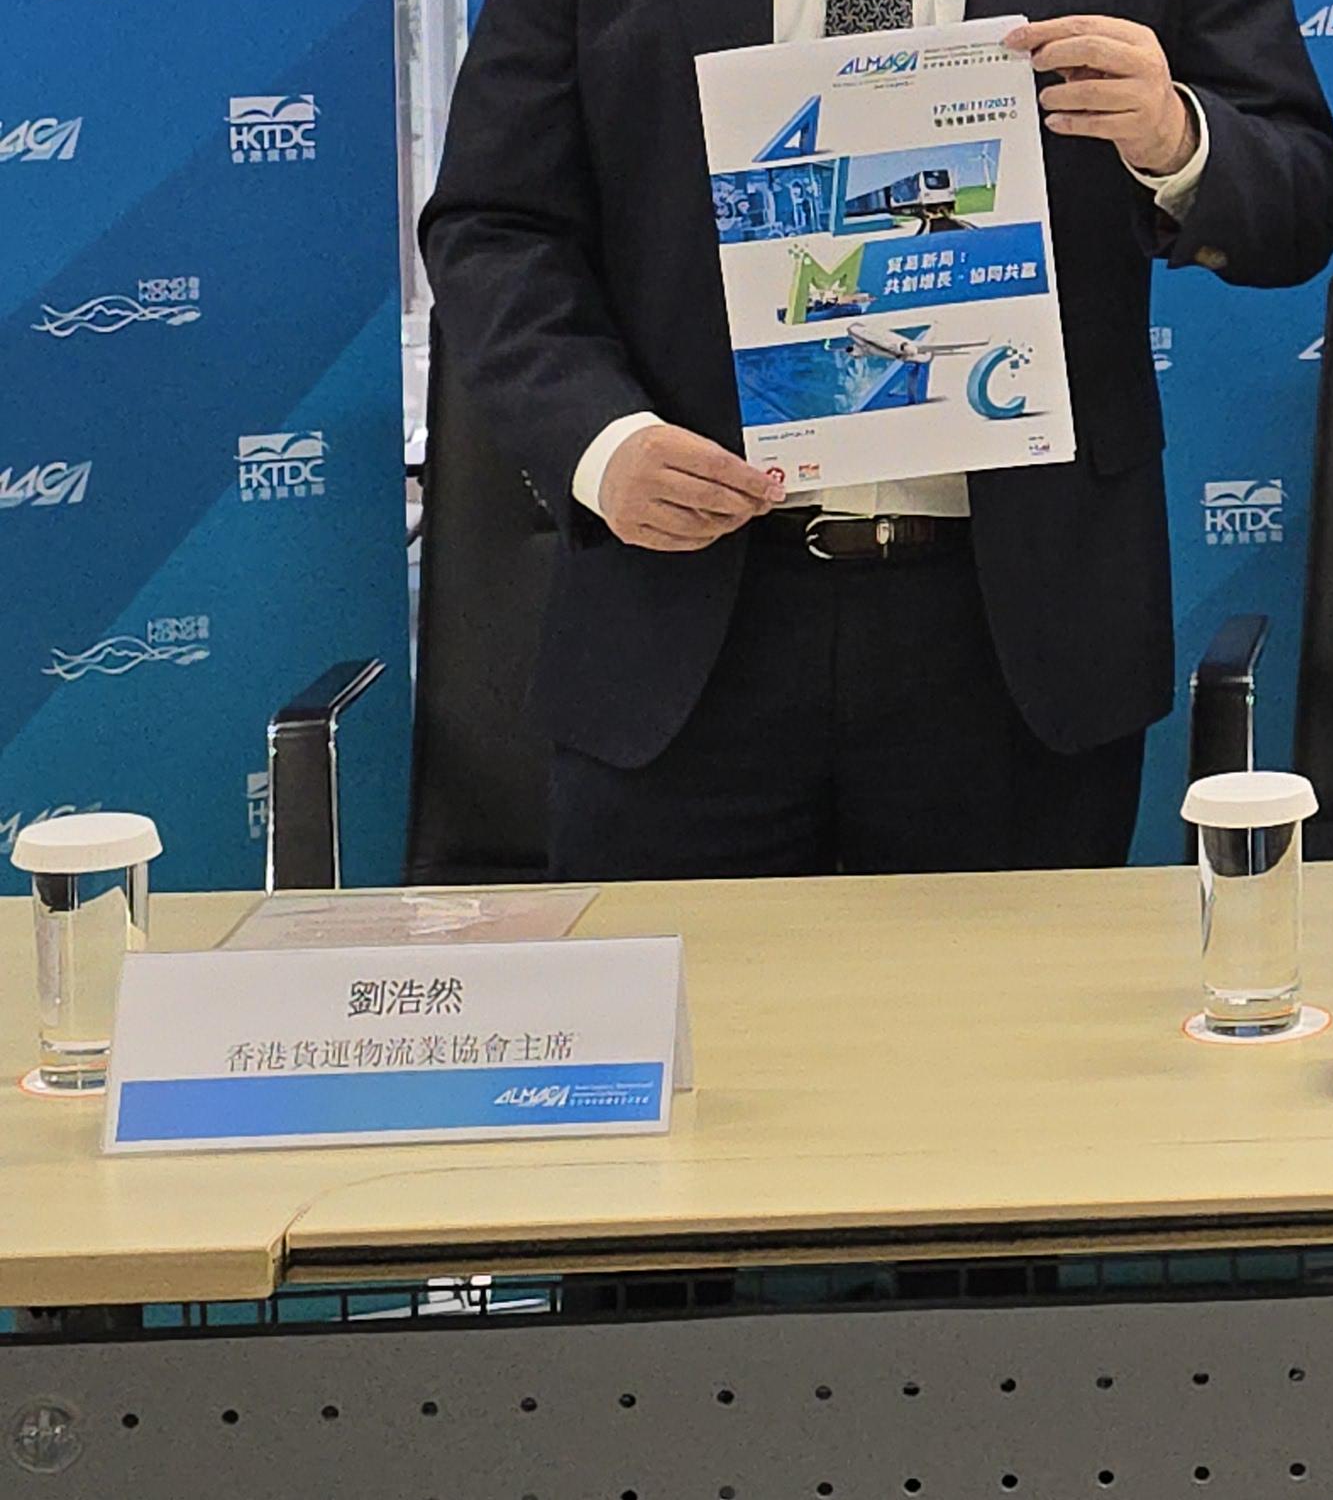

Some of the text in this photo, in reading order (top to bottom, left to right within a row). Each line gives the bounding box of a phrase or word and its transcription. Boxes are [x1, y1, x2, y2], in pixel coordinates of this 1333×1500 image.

[230, 123, 317, 151] HKTDC
[239, 459, 326, 488] HKTDC
[1204, 508, 1283, 532] HKTDC
[347, 976, 464, 1018] 劉浩然
[224, 1030, 576, 1074] 香港貨運物流業協會主席
